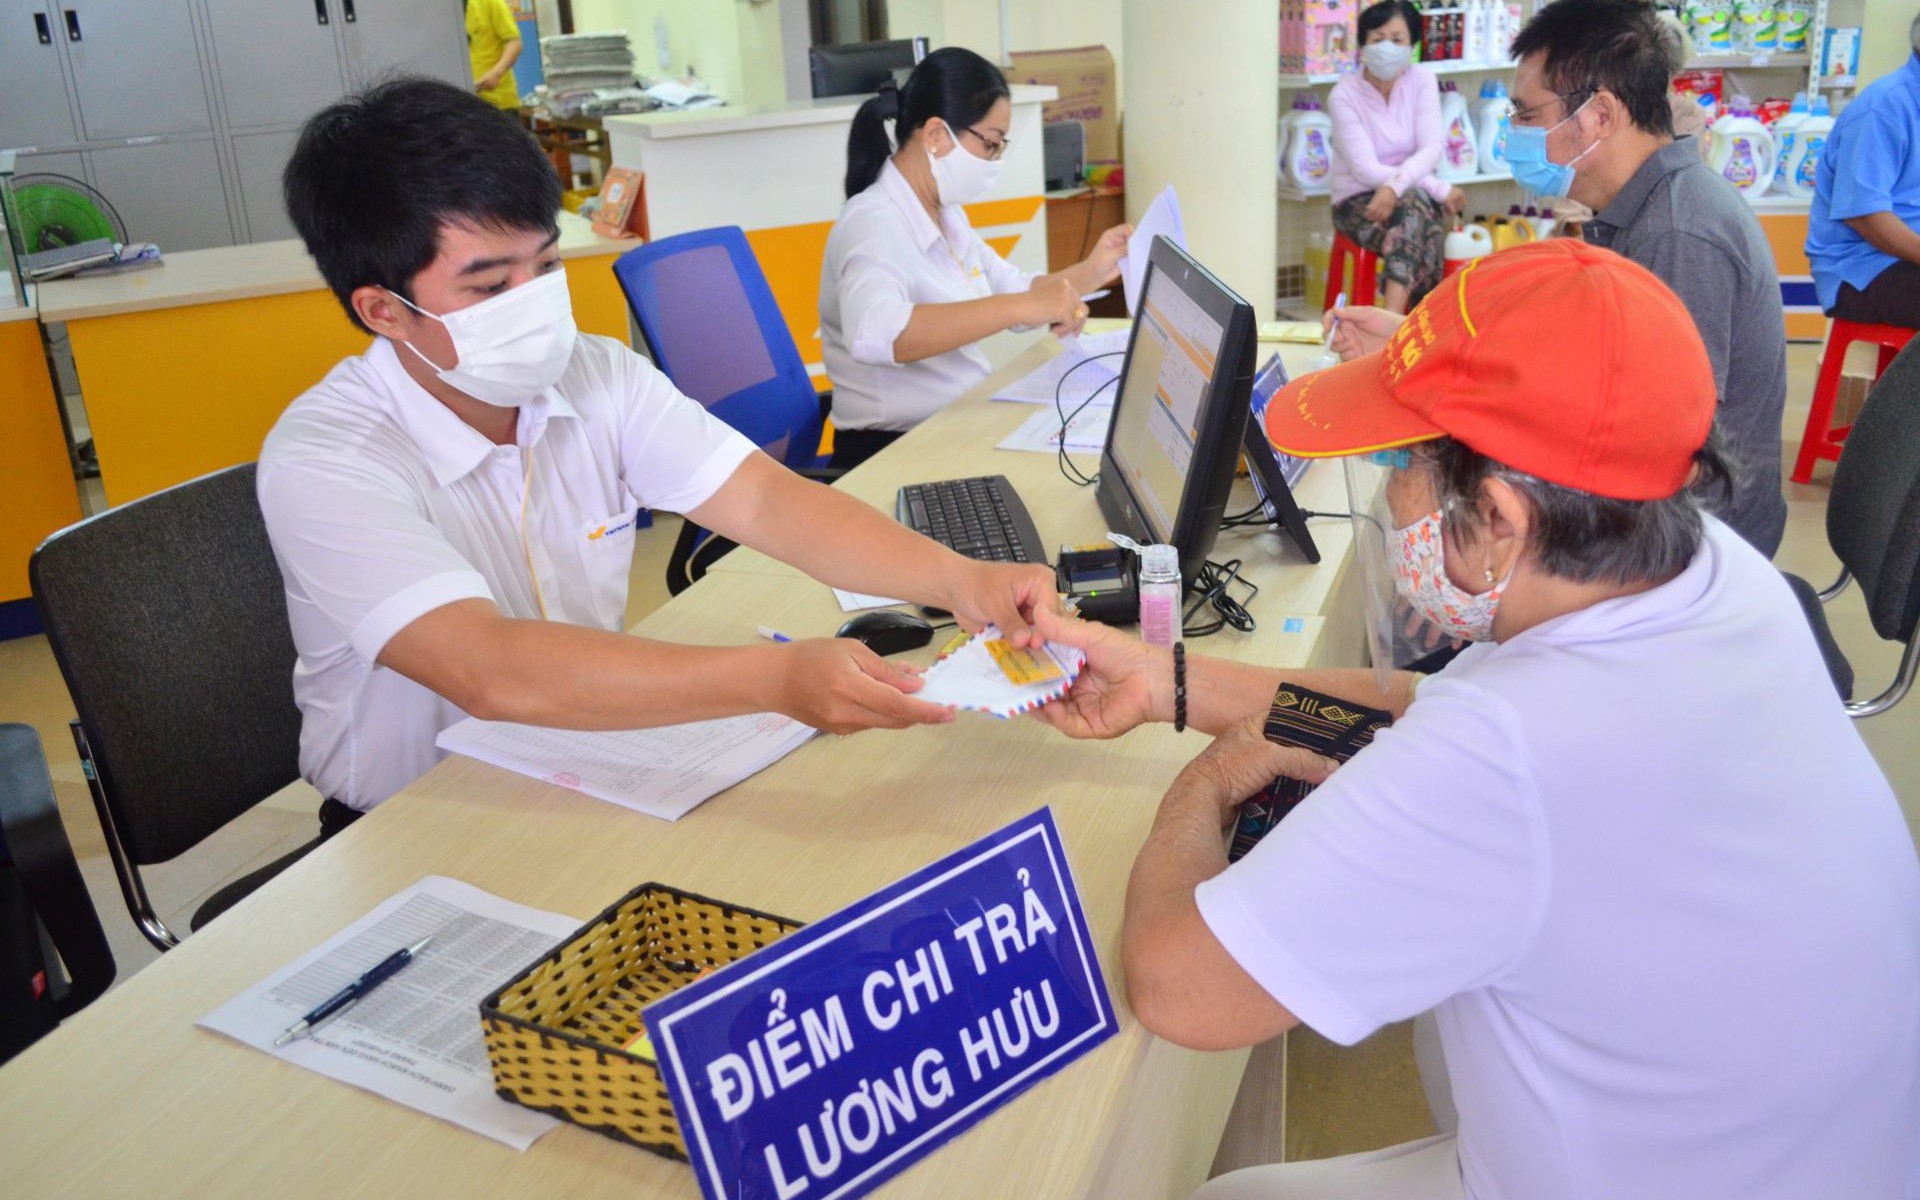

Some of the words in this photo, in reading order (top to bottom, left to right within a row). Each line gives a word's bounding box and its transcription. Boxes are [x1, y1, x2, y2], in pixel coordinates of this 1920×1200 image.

[706, 988, 854, 1122] ĐIỂM
[862, 939, 954, 1031] CHI
[953, 867, 1057, 975] TRẢ
[764, 1048, 955, 1200] LƯƠNG
[959, 979, 1060, 1081] HƯU
